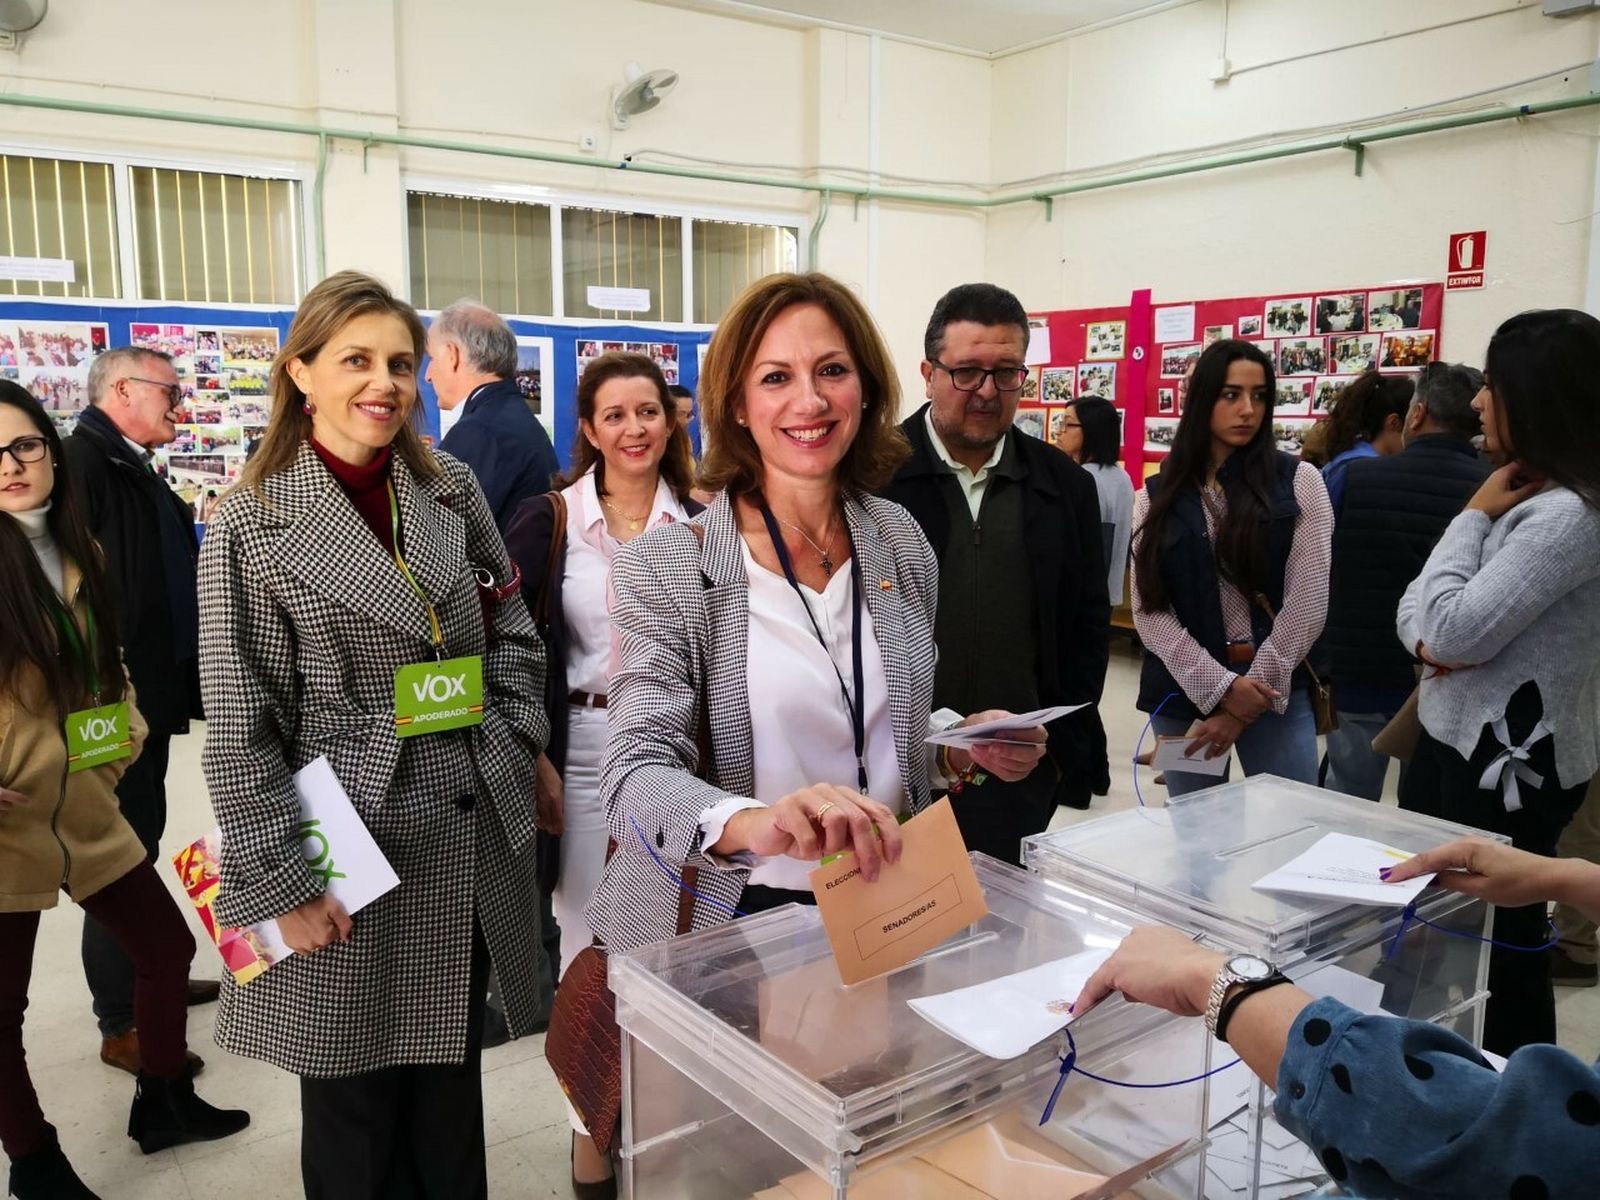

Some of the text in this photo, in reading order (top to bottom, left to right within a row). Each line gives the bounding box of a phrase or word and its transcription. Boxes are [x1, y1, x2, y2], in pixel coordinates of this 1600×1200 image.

[1449, 276, 1482, 286] EXTINTOR
[412, 673, 466, 702] VOX
[413, 707, 468, 723] APODERADO
[79, 716, 118, 741] VOX
[81, 743, 120, 759] APODERADO
